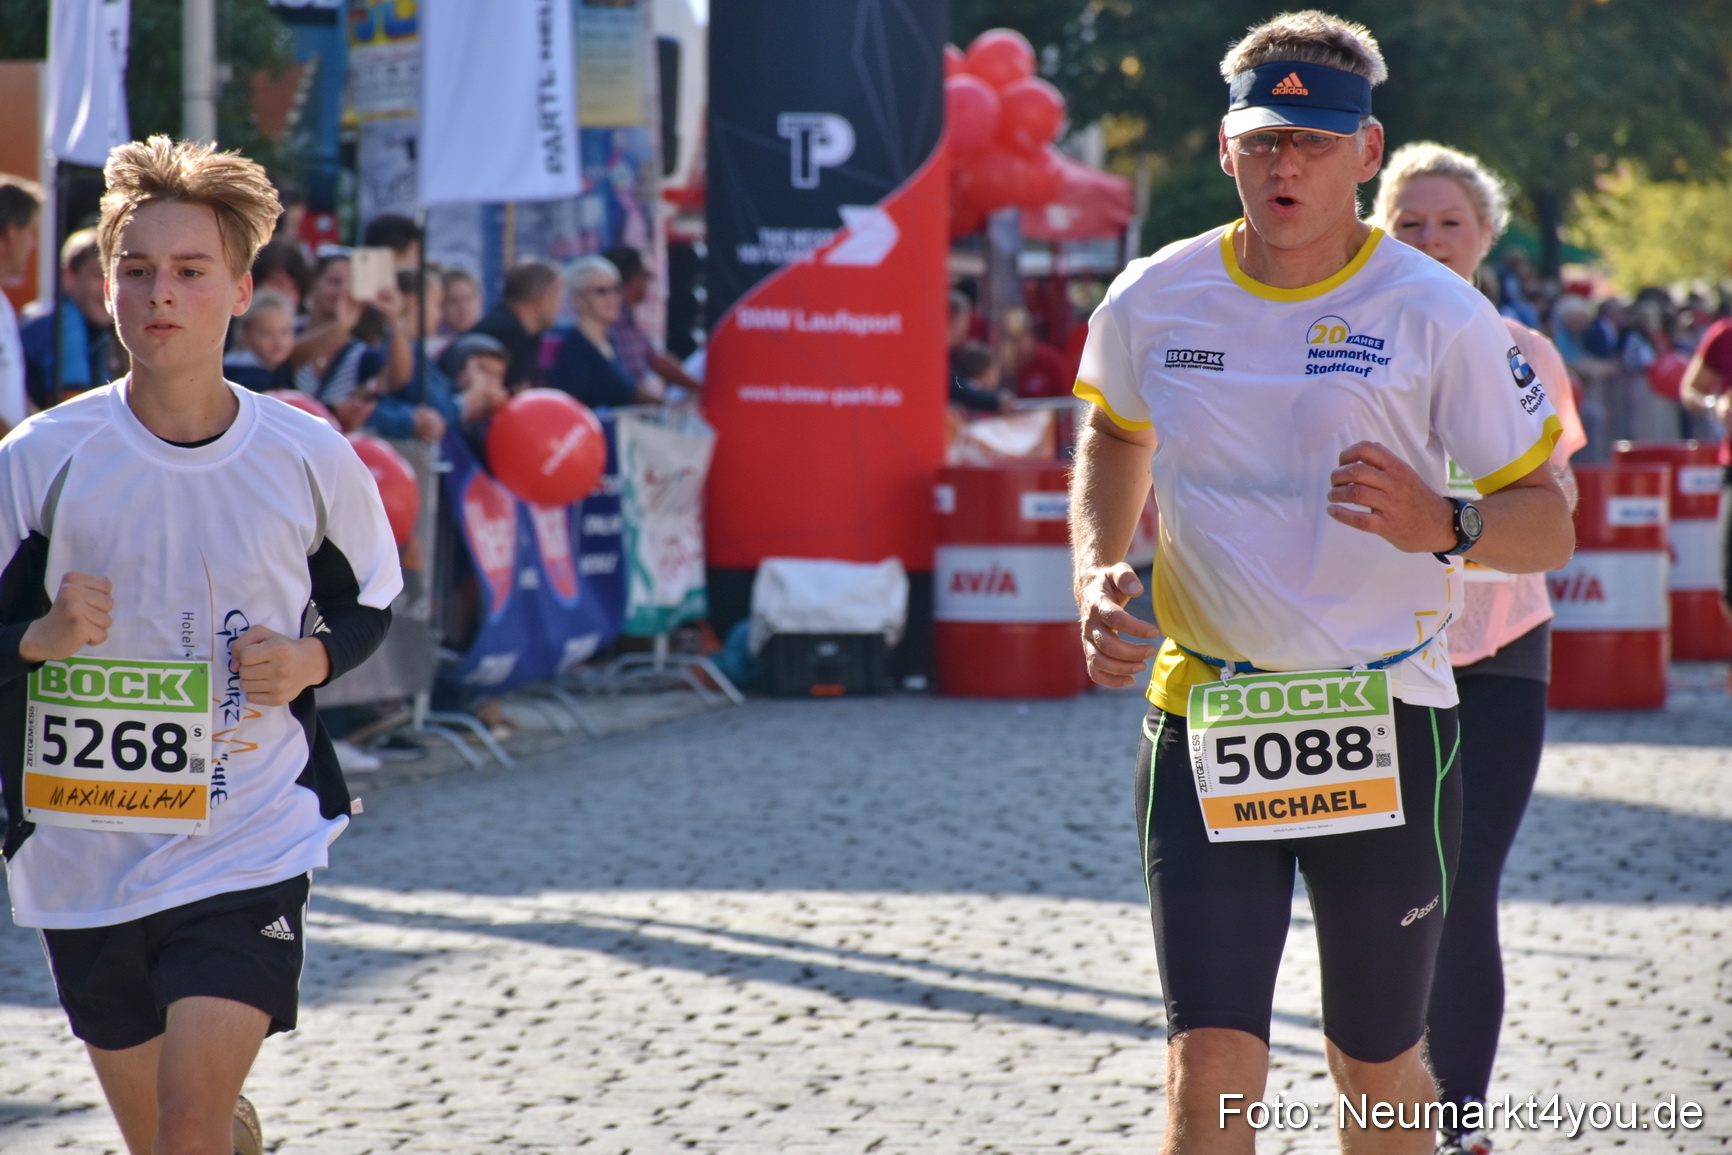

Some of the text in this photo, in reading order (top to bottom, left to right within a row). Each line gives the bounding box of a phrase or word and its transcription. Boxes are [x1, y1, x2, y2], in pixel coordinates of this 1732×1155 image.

[1271, 87, 1309, 96] adidas
[737, 307, 903, 337] BMW Laufsport
[1310, 324, 1347, 344] 20
[1350, 336, 1381, 349] JAHRE
[1166, 349, 1225, 366] BOCK
[1307, 348, 1392, 366] Neumarkter
[1305, 364, 1373, 378] Stadtlauf
[39, 662, 194, 706] BOCK
[1204, 677, 1374, 721] BOCK
[42, 714, 188, 773] 5268
[1216, 726, 1374, 785] 5088
[1234, 790, 1367, 822] MICHAEL
[260, 929, 295, 941] adidas
